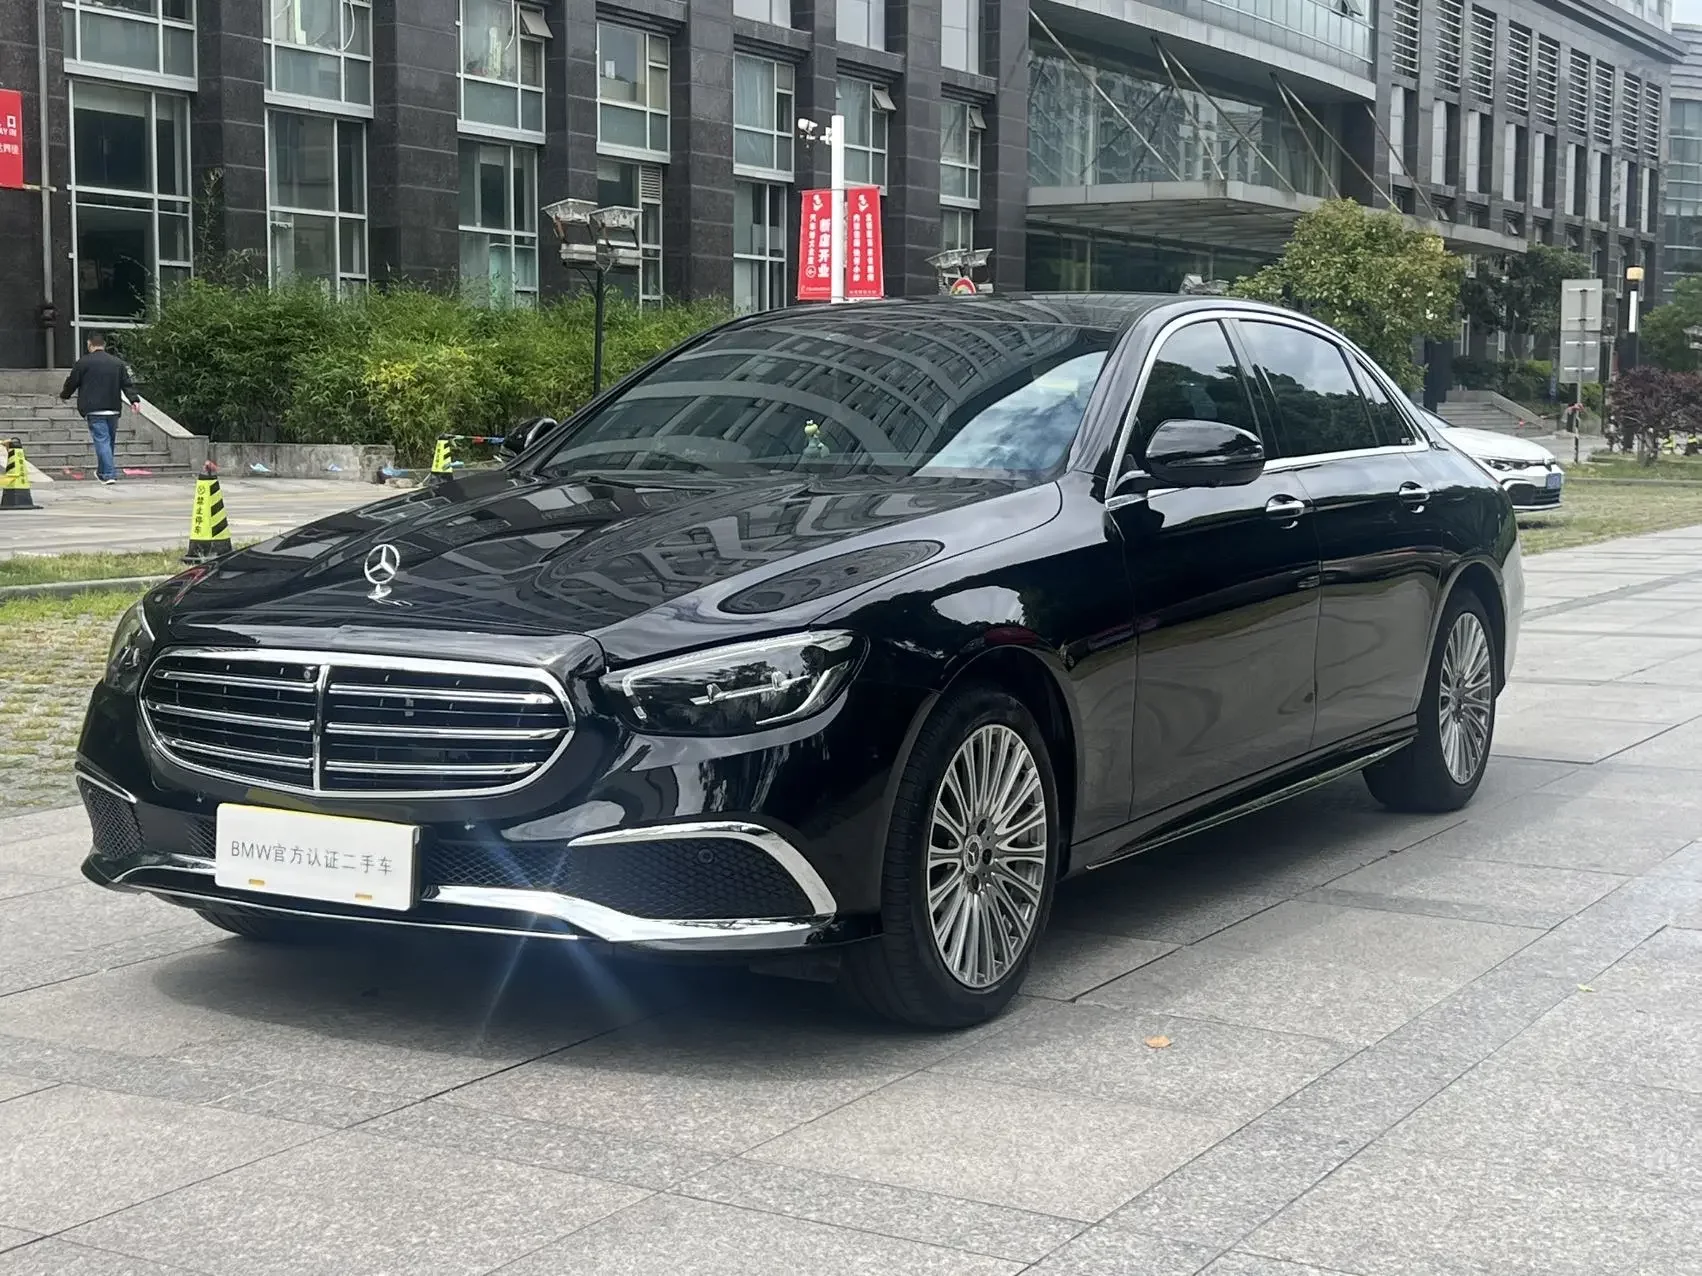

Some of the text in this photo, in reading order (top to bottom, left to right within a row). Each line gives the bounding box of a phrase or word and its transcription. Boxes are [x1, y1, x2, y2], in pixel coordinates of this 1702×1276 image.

[817, 218, 831, 278] 新店开业
[194, 496, 204, 534] 禁止停车
[231, 840, 393, 875] BMW官方认证二手车
